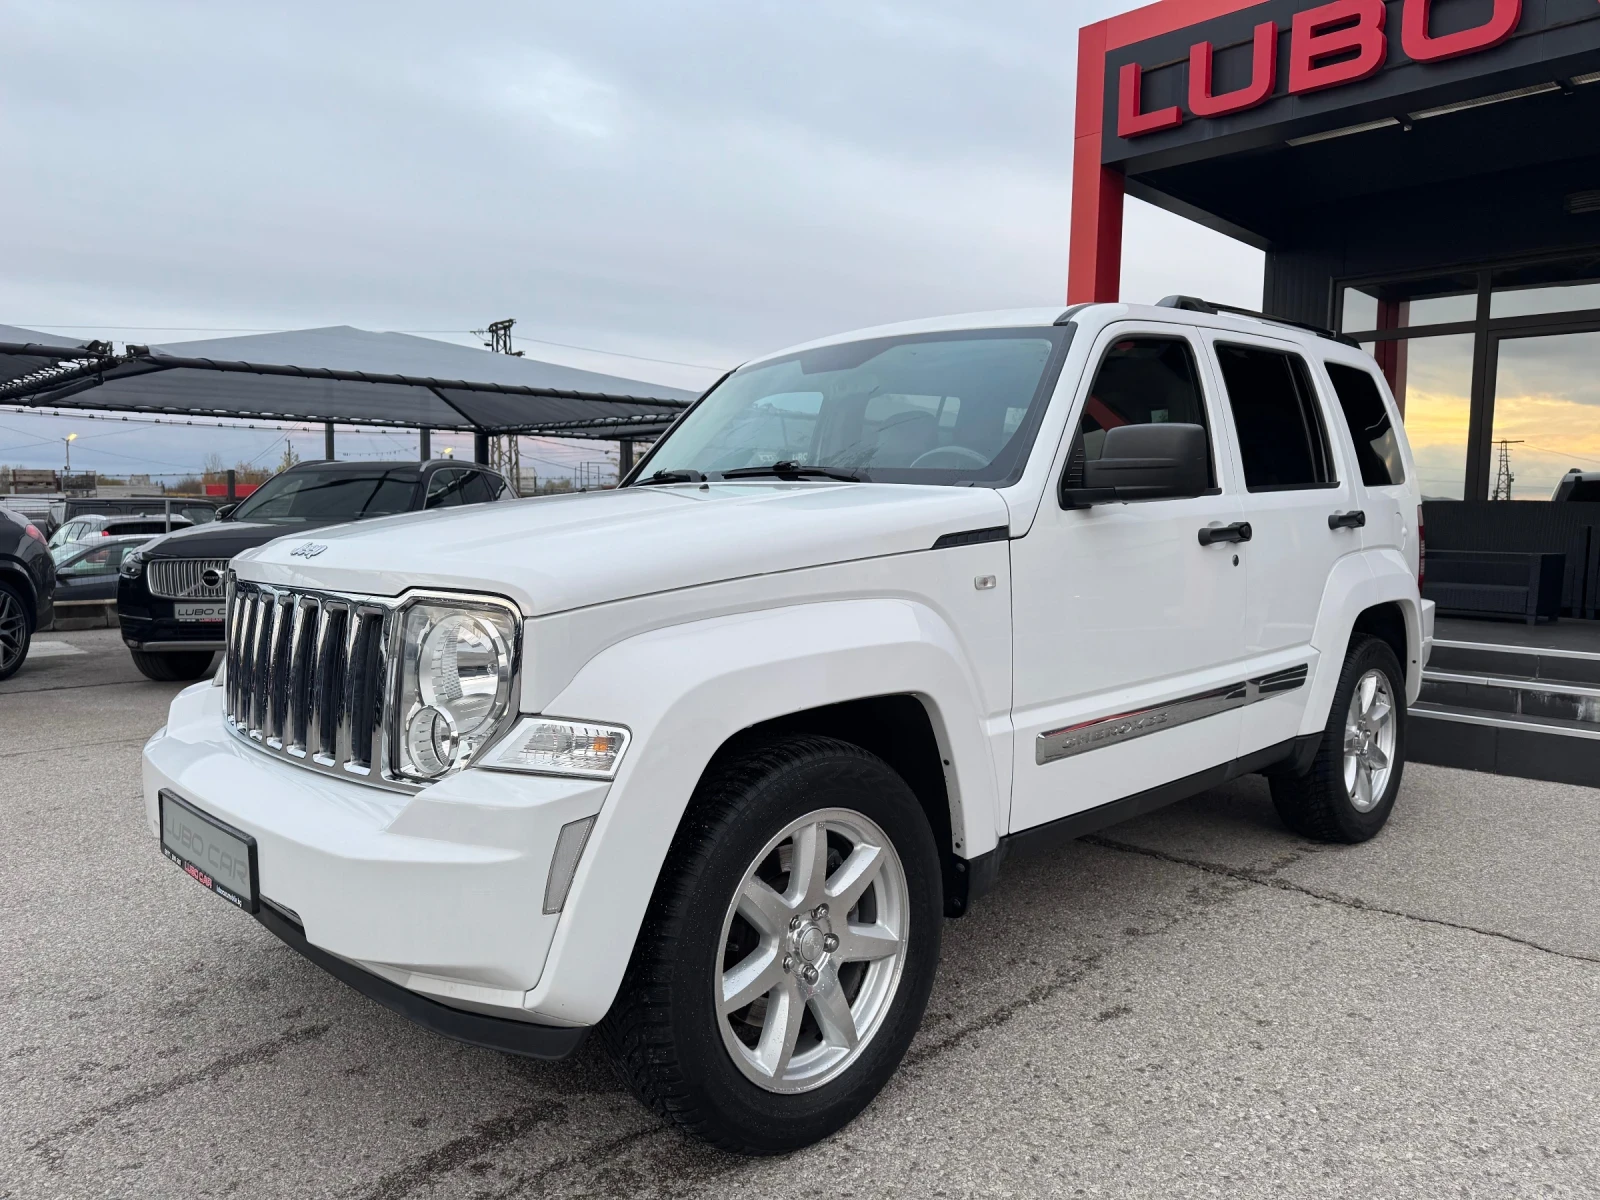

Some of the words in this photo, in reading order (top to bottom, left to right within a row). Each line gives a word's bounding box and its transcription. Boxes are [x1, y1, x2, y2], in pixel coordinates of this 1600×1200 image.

[1117, 0, 1523, 139] LUBO
[178, 608, 215, 616] LUBO
[1062, 712, 1168, 749] CHEROKEE
[165, 813, 203, 857] LUBO
[208, 843, 248, 885] CAR
